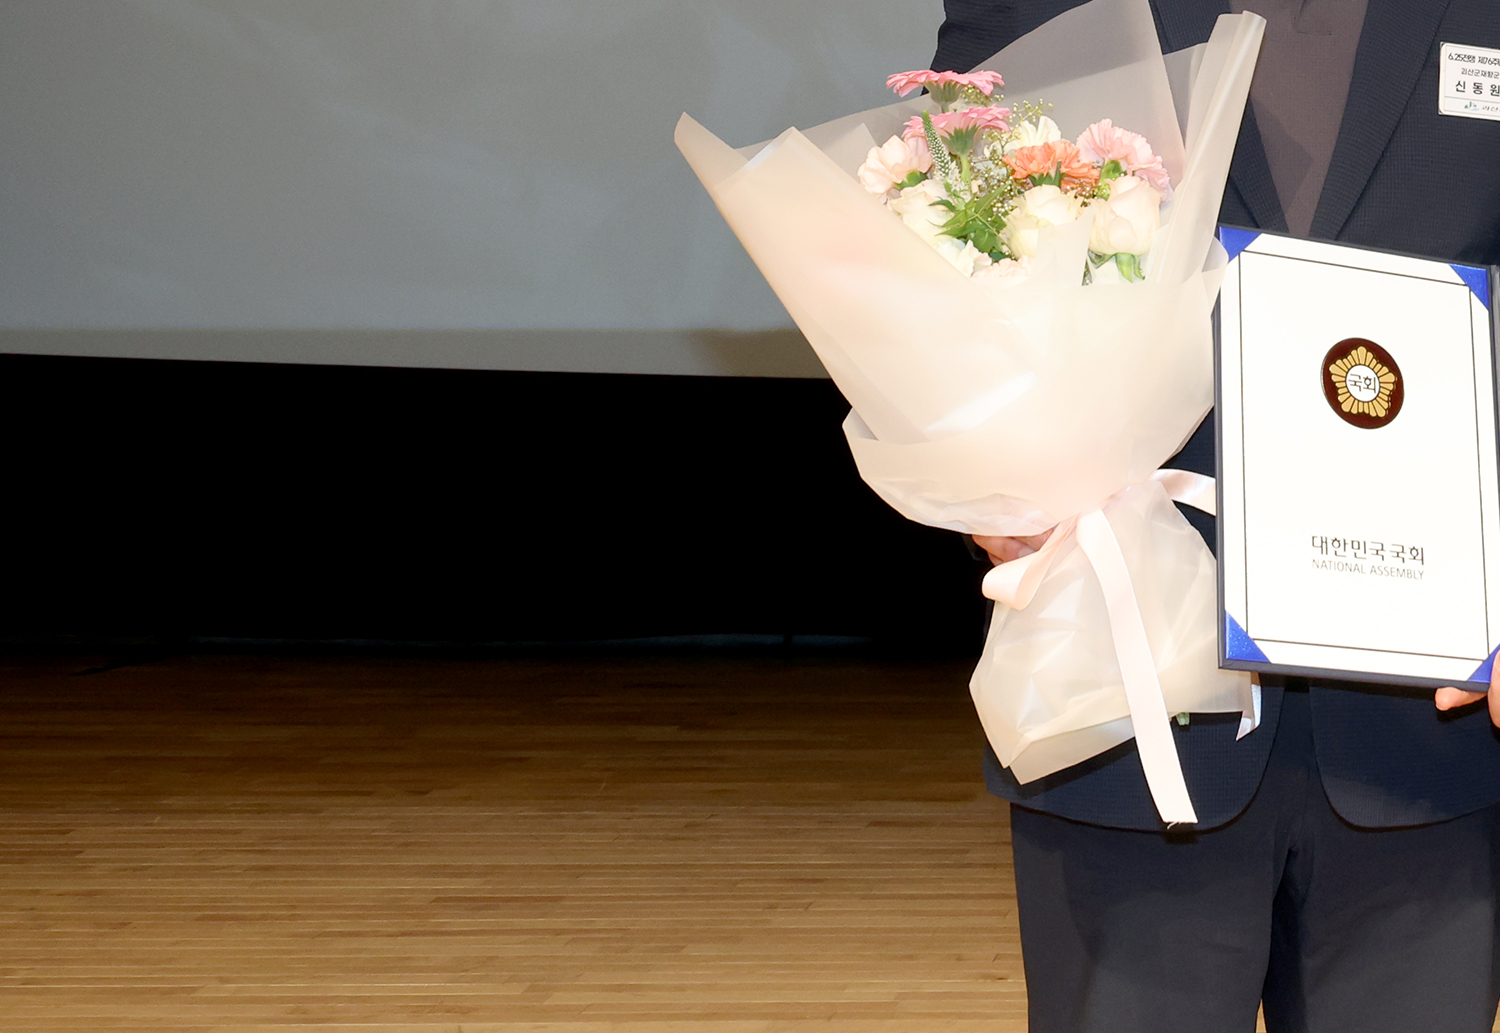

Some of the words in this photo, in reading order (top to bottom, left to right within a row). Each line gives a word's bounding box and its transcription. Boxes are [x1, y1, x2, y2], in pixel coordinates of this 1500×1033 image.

[1348, 373, 1377, 394] 국회
[1312, 559, 1367, 574] NATIONAL
[1369, 565, 1424, 580] ASSEMBLY
